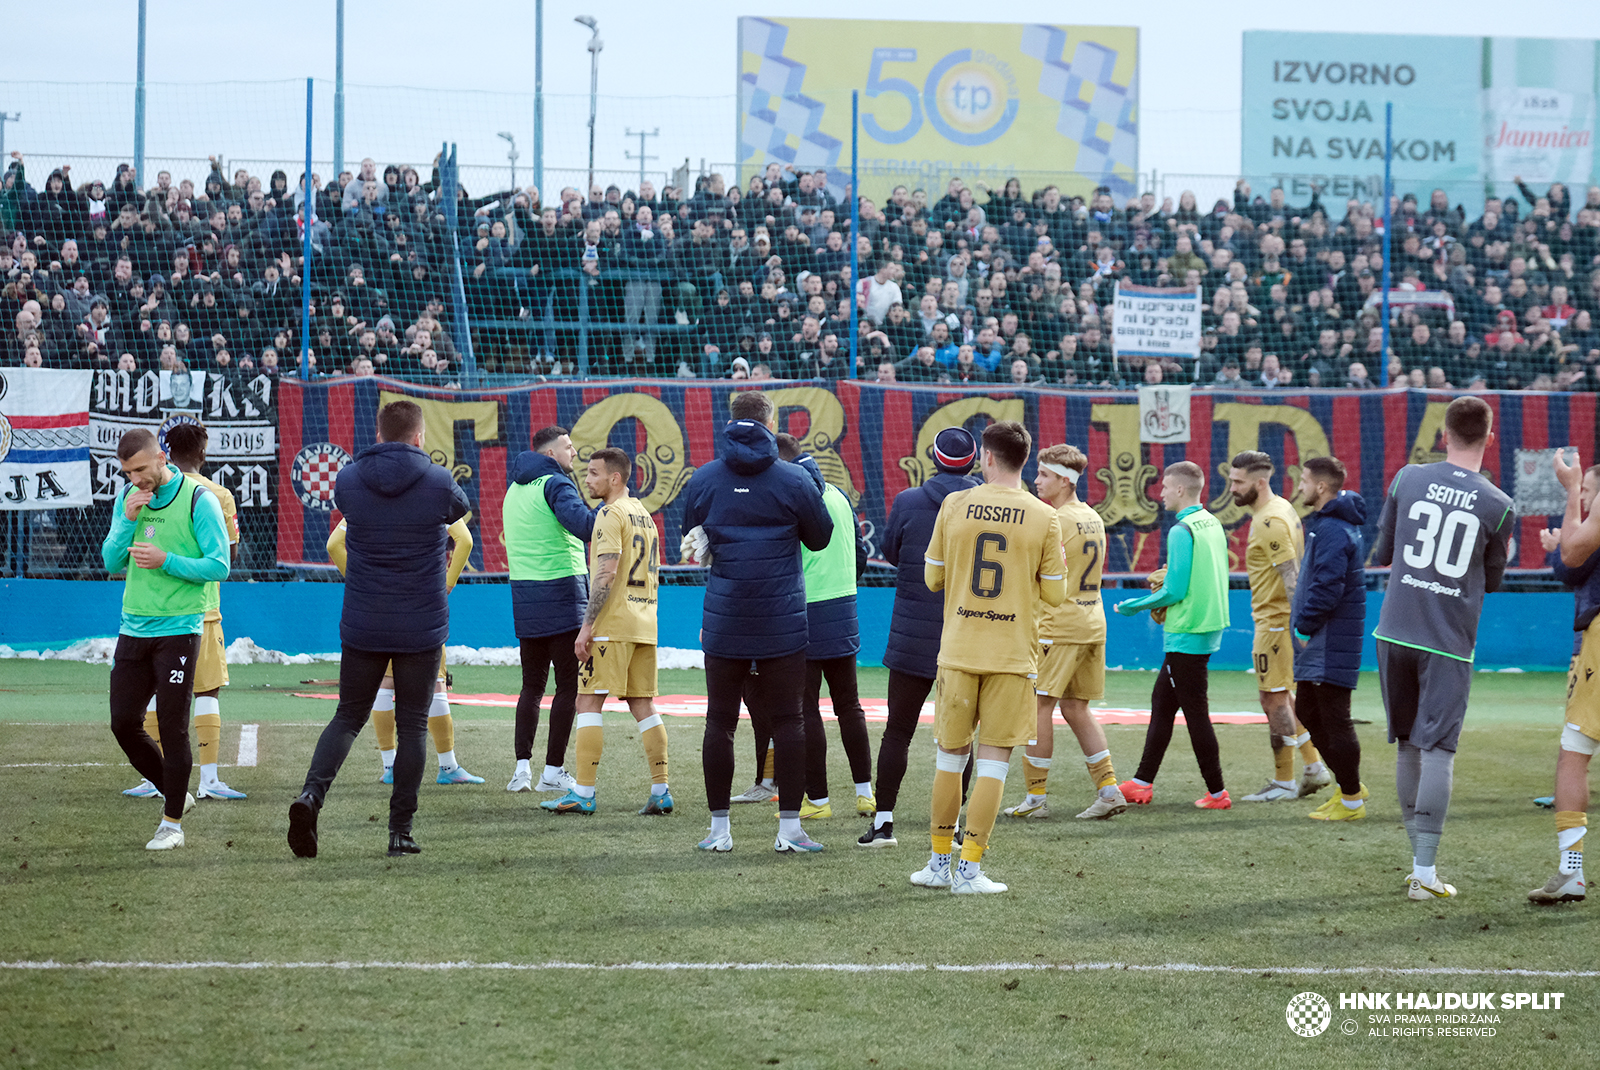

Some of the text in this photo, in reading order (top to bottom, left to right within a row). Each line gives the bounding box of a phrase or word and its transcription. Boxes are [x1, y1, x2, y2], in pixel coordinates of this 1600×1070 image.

[1273, 61, 1416, 86] IZVORNO
[861, 48, 1020, 146] 50
[1272, 98, 1373, 123] SVOJA
[1486, 121, 1590, 149] Jamnica
[1272, 137, 1456, 162] NA SVAKOM
[220, 432, 264, 453] BOYS
[297, 444, 351, 466] HAJDUK
[0, 470, 70, 503] JA
[1426, 483, 1478, 510] SENTIĆ
[301, 492, 338, 511] SPLI
[966, 504, 1025, 525] FOSSATI
[1403, 500, 1480, 579] 30
[627, 534, 658, 590] 24
[970, 530, 1008, 600] 6
[1401, 574, 1461, 597] SuperSport
[957, 606, 1016, 622] SuperSport
[1254, 653, 1269, 674] 10
[169, 670, 184, 684] 29
